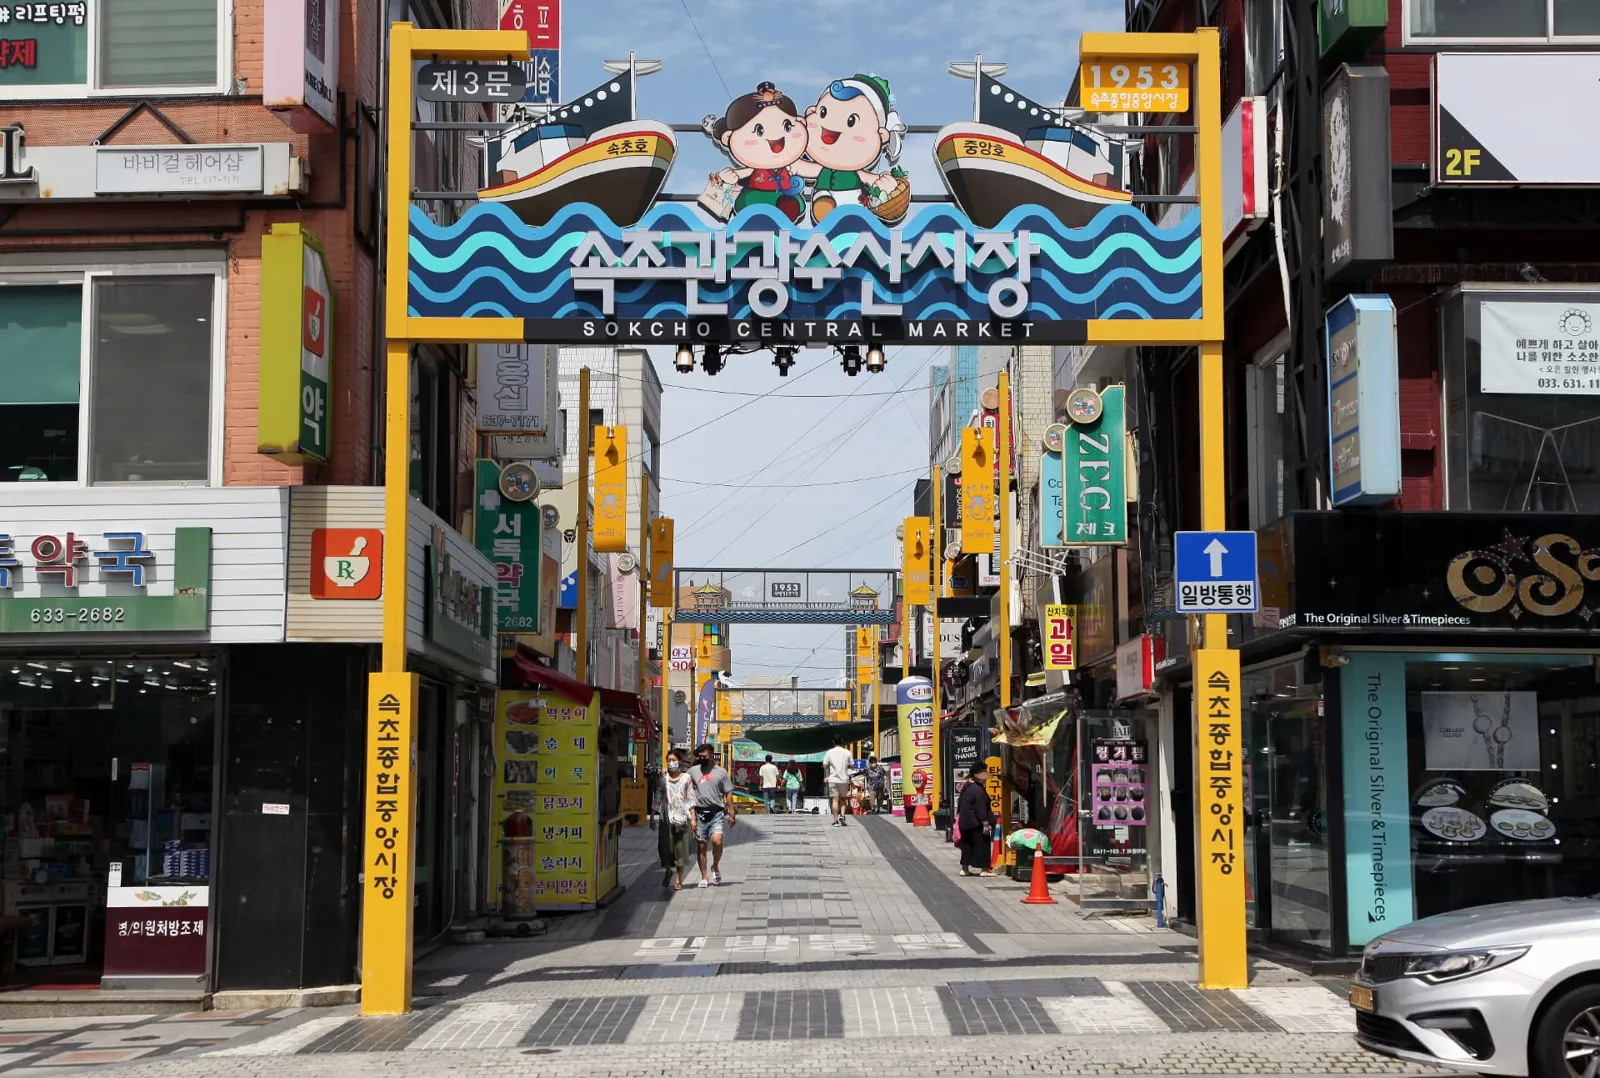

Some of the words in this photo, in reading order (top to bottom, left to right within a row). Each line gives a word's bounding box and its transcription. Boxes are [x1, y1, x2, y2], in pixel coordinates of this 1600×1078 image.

[15, 2, 86, 25] 리프팅펌
[1090, 65, 1179, 89] 1953
[1090, 92, 1179, 110] 속초종합중앙시장
[607, 141, 649, 156] 속초호
[963, 140, 1005, 159] 중앙호
[123, 153, 180, 173] 바비걸
[185, 153, 243, 172] 헤어샵
[1445, 149, 1481, 175] 2F
[569, 228, 1042, 318] 속초관광수산시장
[583, 321, 711, 338] SOKCHO
[737, 321, 884, 338] CENTRAL
[908, 321, 1035, 338] MARKET
[1553, 340, 1574, 350] 하고
[1517, 352, 1537, 361] 나를
[1541, 352, 1562, 361] 위한
[302, 384, 324, 446] 약
[483, 415, 541, 428] 637-7171
[774, 583, 799, 591] 1953
[1181, 584, 1252, 606] 일방통행
[31, 608, 125, 622] 633-2682
[1304, 613, 1325, 623] The
[1327, 613, 1370, 626] Original
[1050, 618, 1073, 665] 과일
[1367, 672, 1381, 701] The
[546, 706, 587, 721] 떡볶이
[1365, 706, 1383, 772] Original
[1208, 670, 1236, 876] 속초종합중앙시장
[373, 693, 401, 900] 속초종합중앙시장
[543, 796, 584, 810] 닭꼬치
[542, 826, 583, 839] 냉커피
[541, 856, 583, 870] 슬러시
